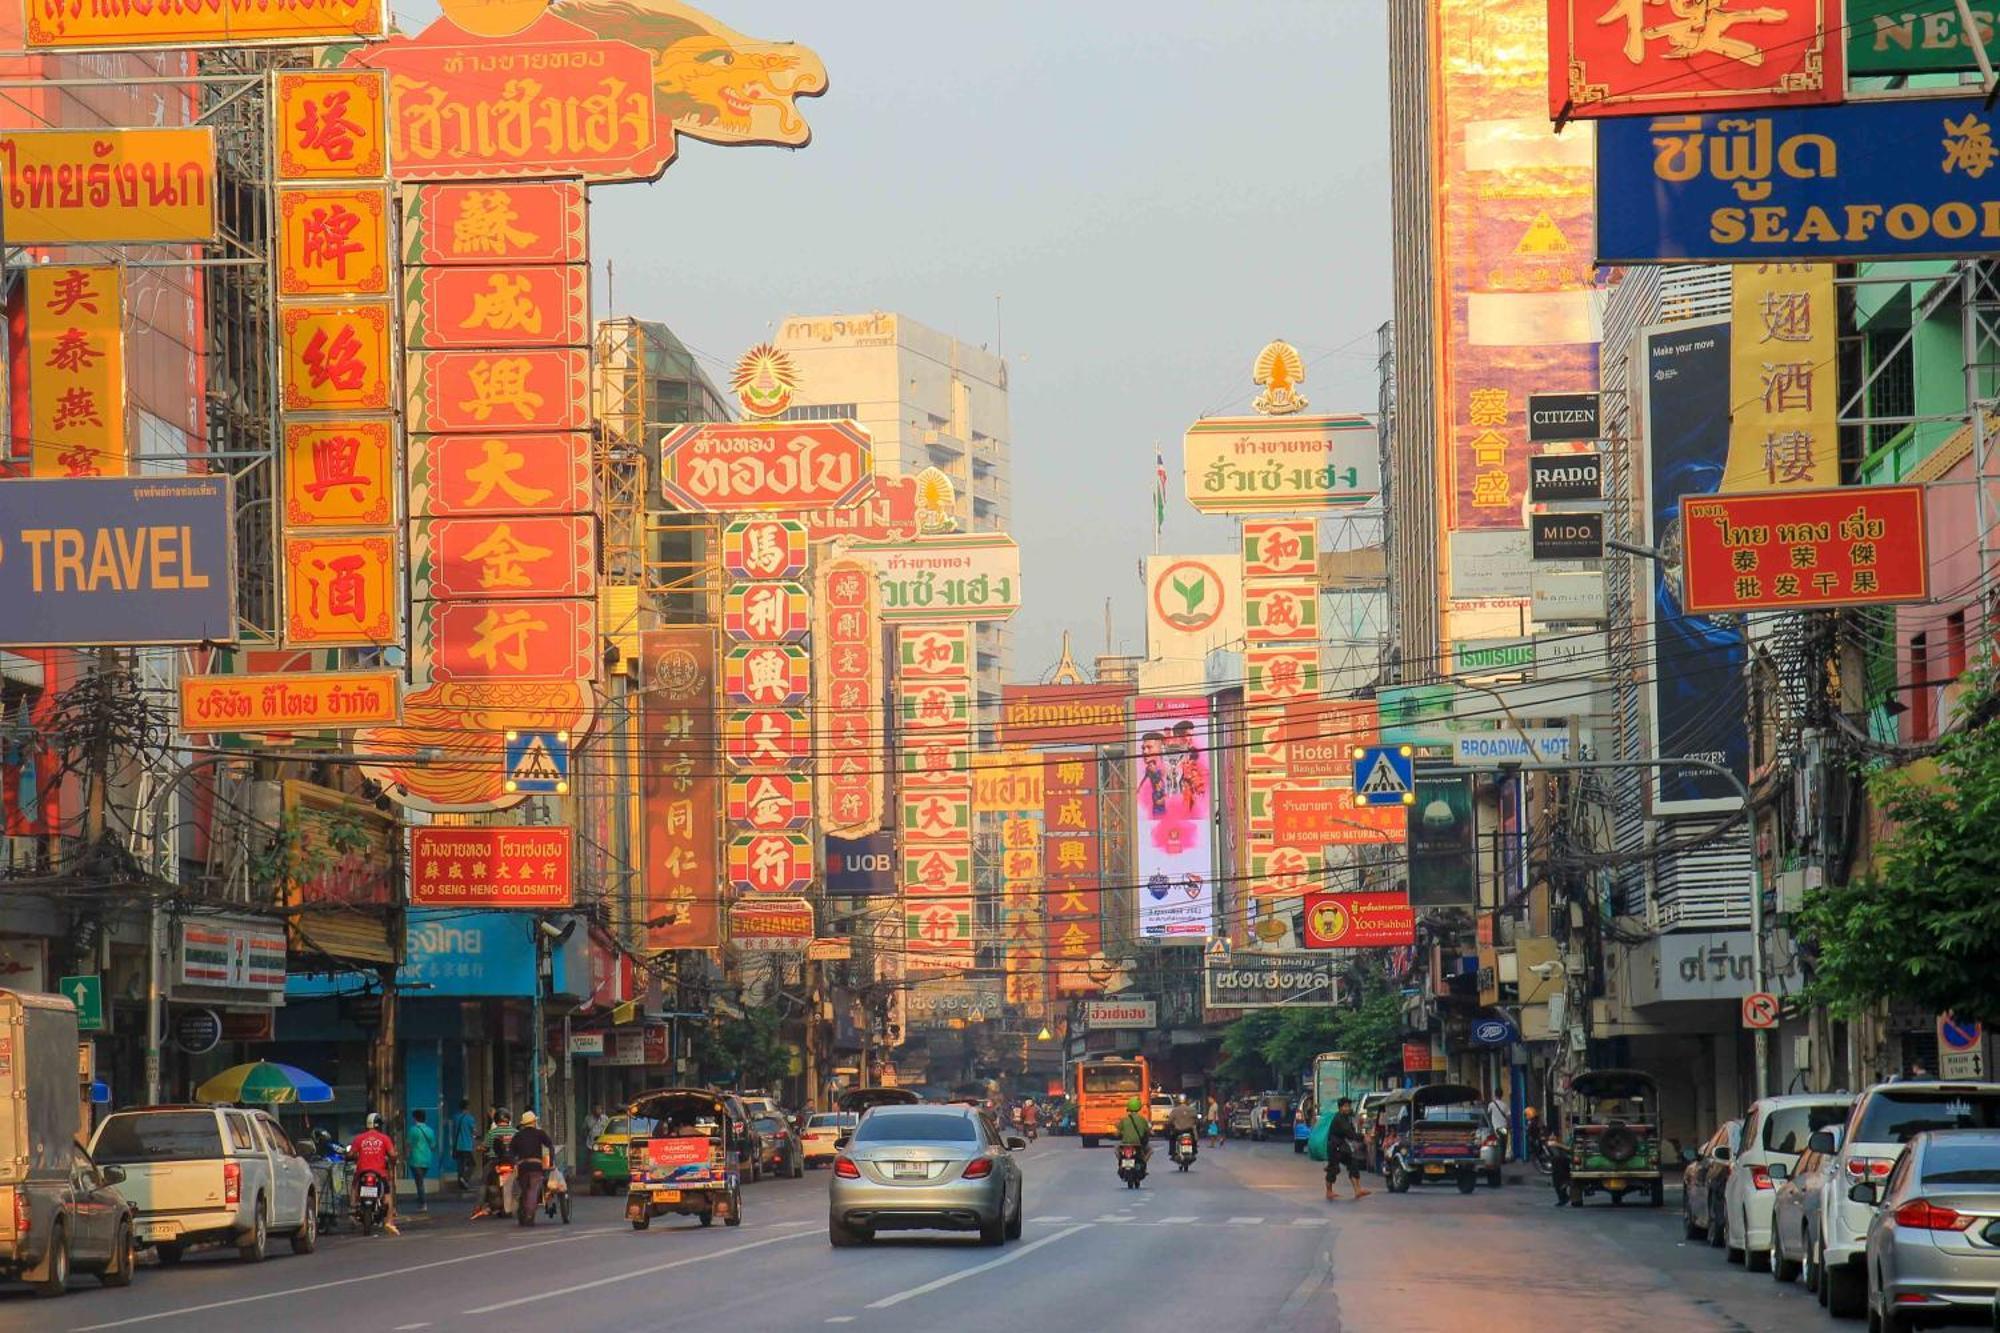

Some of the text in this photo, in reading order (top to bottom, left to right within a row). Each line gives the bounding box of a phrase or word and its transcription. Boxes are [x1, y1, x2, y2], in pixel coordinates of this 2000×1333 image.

[444, 51, 605, 73] ห้างขายทอง
[0, 139, 205, 209] ไทยรังนก
[1653, 339, 1714, 357] Make your move
[1533, 409, 1595, 425] CITIZEN
[453, 190, 554, 671] 蘇成興大金行
[693, 432, 776, 455] ห้างทอง
[1234, 436, 1334, 455] ห้างขายทอง
[1470, 388, 1510, 509] 蔡合盛
[1535, 466, 1598, 484] RADO
[1544, 526, 1590, 540] MIDO
[1714, 518, 1769, 547] ไทย
[1776, 521, 1831, 544] หลง
[21, 525, 209, 593] TRAVEL
[1735, 570, 1880, 600] 批发干果
[198, 688, 252, 719] บริษัท
[327, 684, 380, 715] จำกัด
[746, 525, 793, 888] 馬利興大金行
[1292, 744, 1338, 760] Hotel
[1461, 739, 1535, 756] BROADWAY
[1293, 764, 1332, 775] Bangkok
[918, 637, 958, 943] 和成興大金行
[662, 709, 698, 926] 北京同仁堂
[425, 860, 557, 880] 蘇成興大金行
[846, 855, 891, 873] UOB
[420, 884, 562, 895] SO SENG HENG GOLDSMITH
